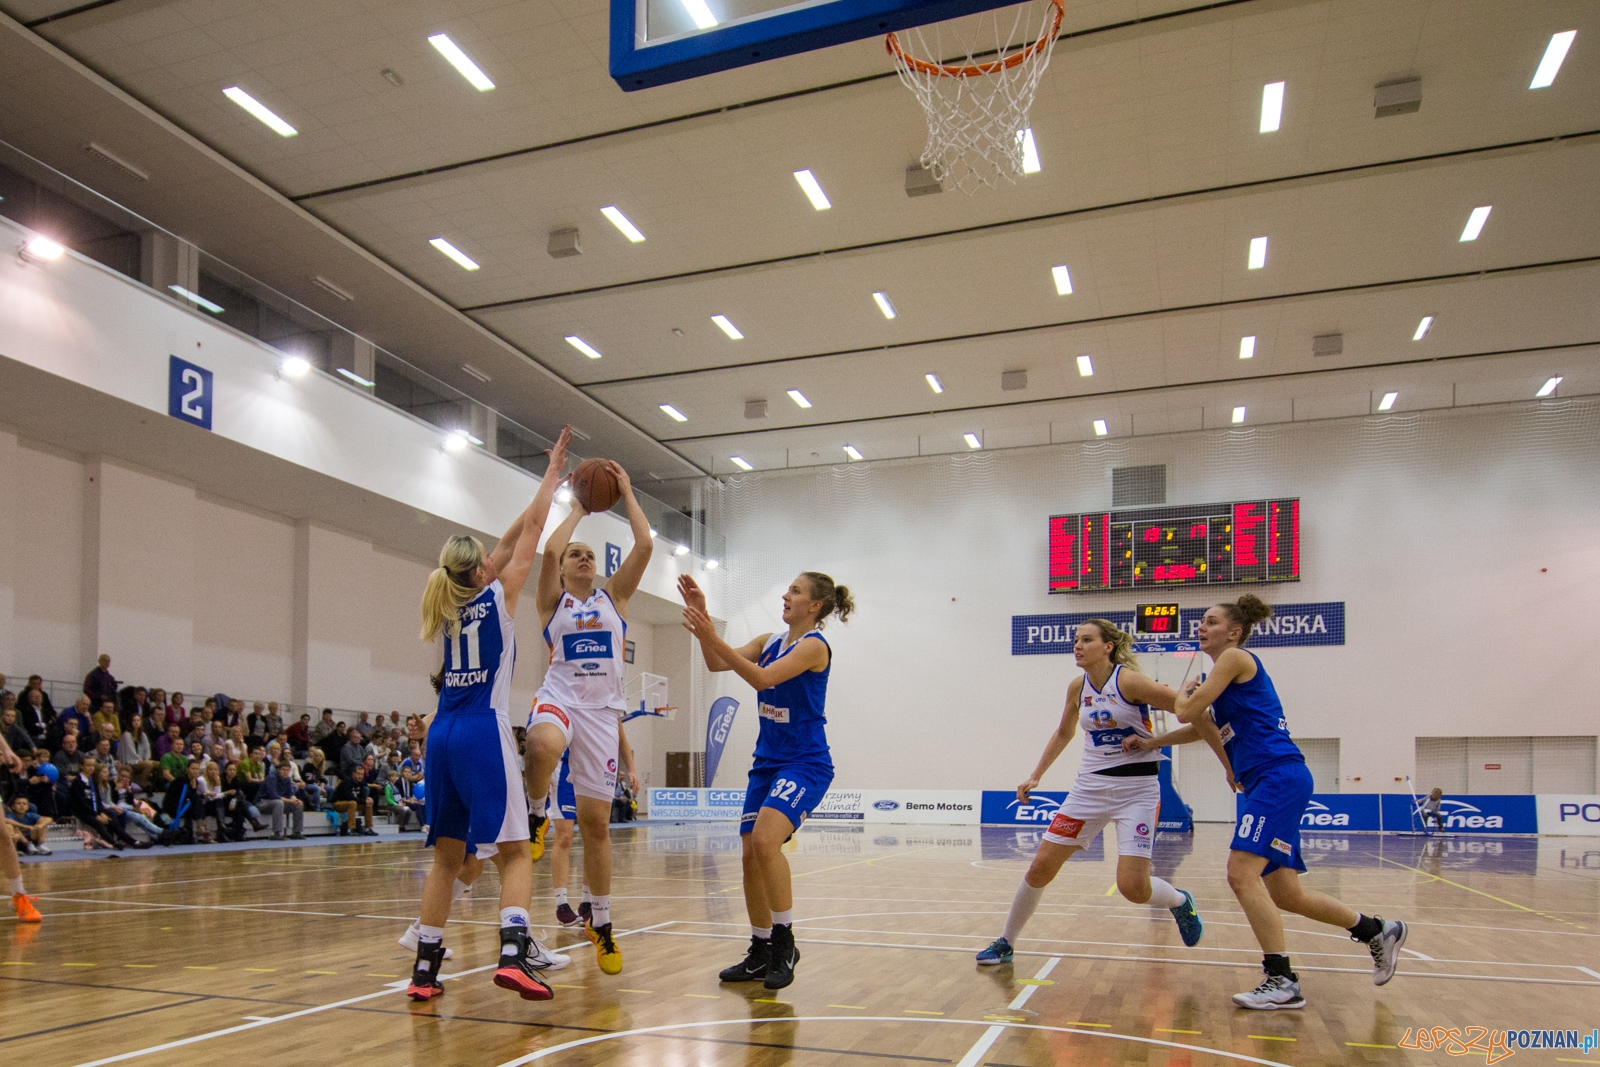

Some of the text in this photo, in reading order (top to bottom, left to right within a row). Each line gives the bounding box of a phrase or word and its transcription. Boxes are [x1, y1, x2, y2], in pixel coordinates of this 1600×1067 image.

[181, 368, 203, 420] 2
[609, 547, 618, 575] 3
[572, 610, 602, 631] 12
[1145, 606, 1176, 616] 8.26.5
[1152, 617, 1169, 632] 10
[1189, 612, 1327, 638] PAŃSKA
[449, 619, 482, 670] 11
[575, 643, 607, 653] Enea
[714, 705, 736, 744] Enea
[1089, 709, 1117, 729] 13
[770, 778, 797, 802] 32
[906, 802, 973, 812] Bemo Motors
[1015, 805, 1057, 821] Ene
[1238, 813, 1254, 838] 8
[1300, 813, 1350, 826] nea
